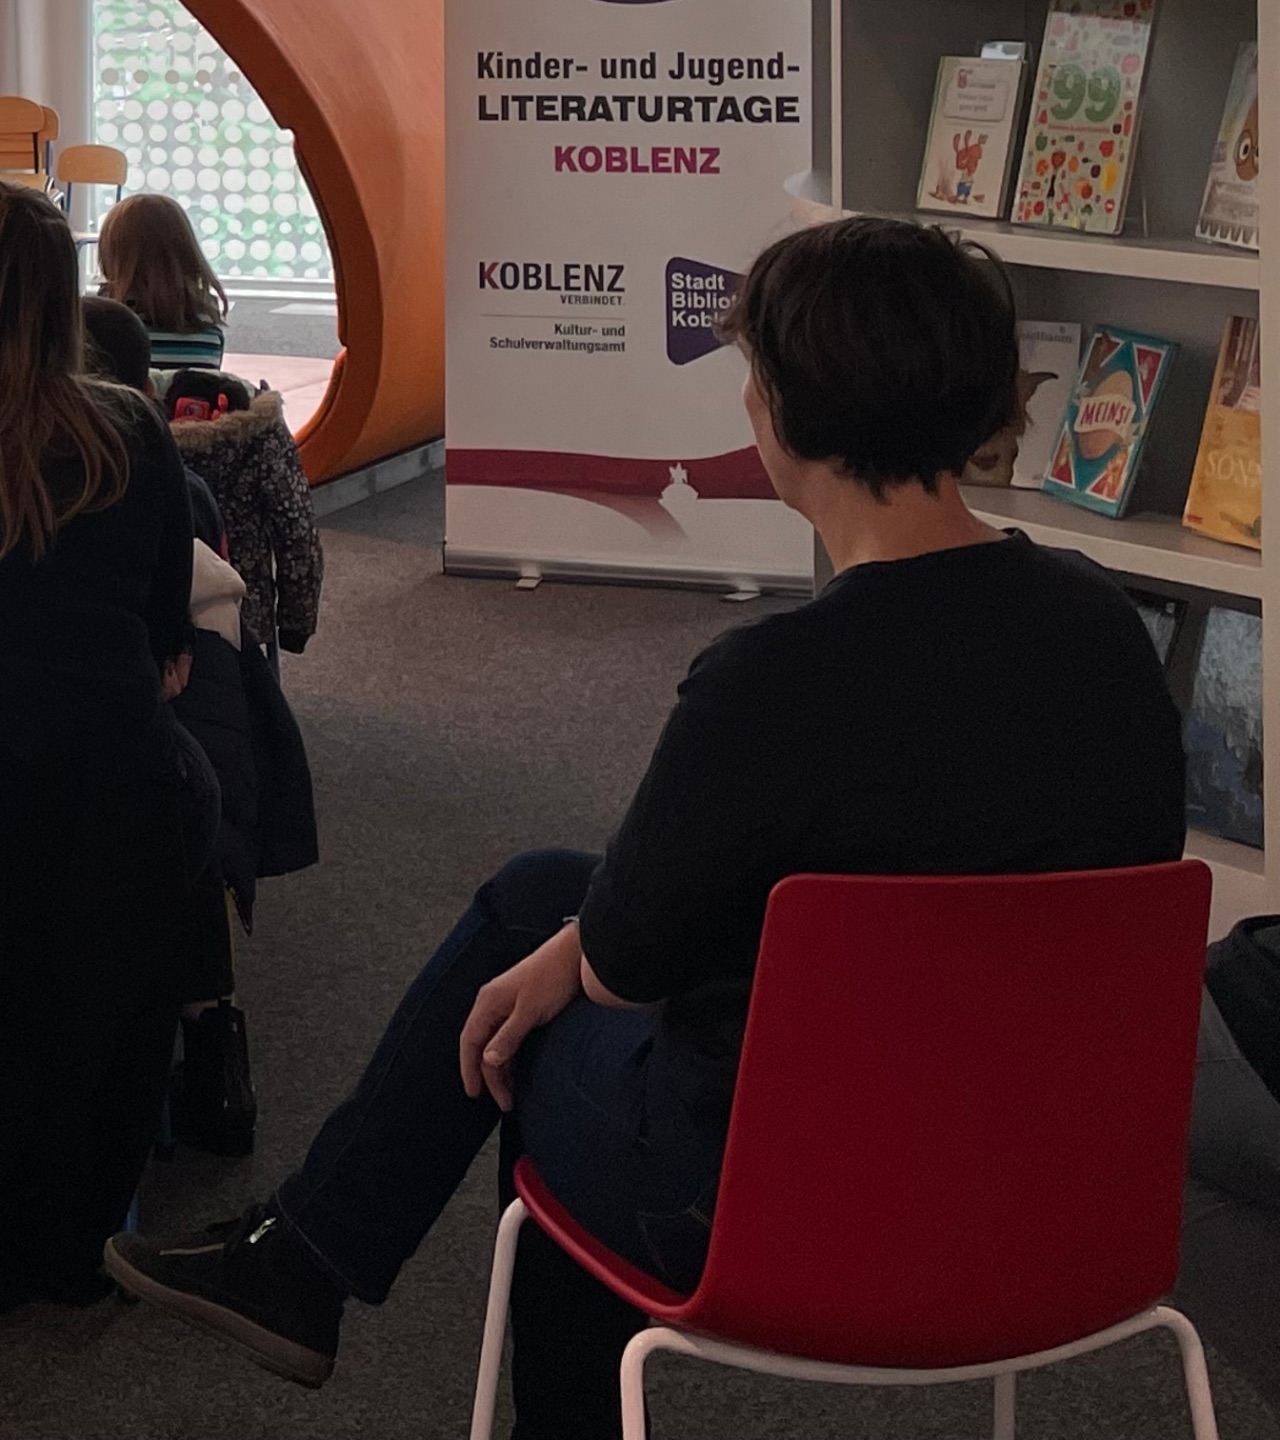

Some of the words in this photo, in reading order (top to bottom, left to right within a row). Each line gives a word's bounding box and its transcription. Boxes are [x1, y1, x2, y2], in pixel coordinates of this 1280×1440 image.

[476, 51, 589, 80] Kinder-
[599, 51, 657, 80] und
[668, 51, 801, 86] Jugend-
[1049, 62, 1122, 123] 99
[476, 94, 801, 124] LITERATURTAGE
[553, 144, 721, 175] KOBLENZ
[478, 261, 626, 293] KOBLENZ
[670, 272, 726, 292] Stadt
[670, 291, 737, 310] Biblio
[553, 323, 598, 337] Kultur-
[601, 325, 626, 337] und
[670, 310, 721, 328] Kob
[489, 336, 626, 354] Schulverwaltungsamt
[1079, 401, 1131, 427] MEINS!
